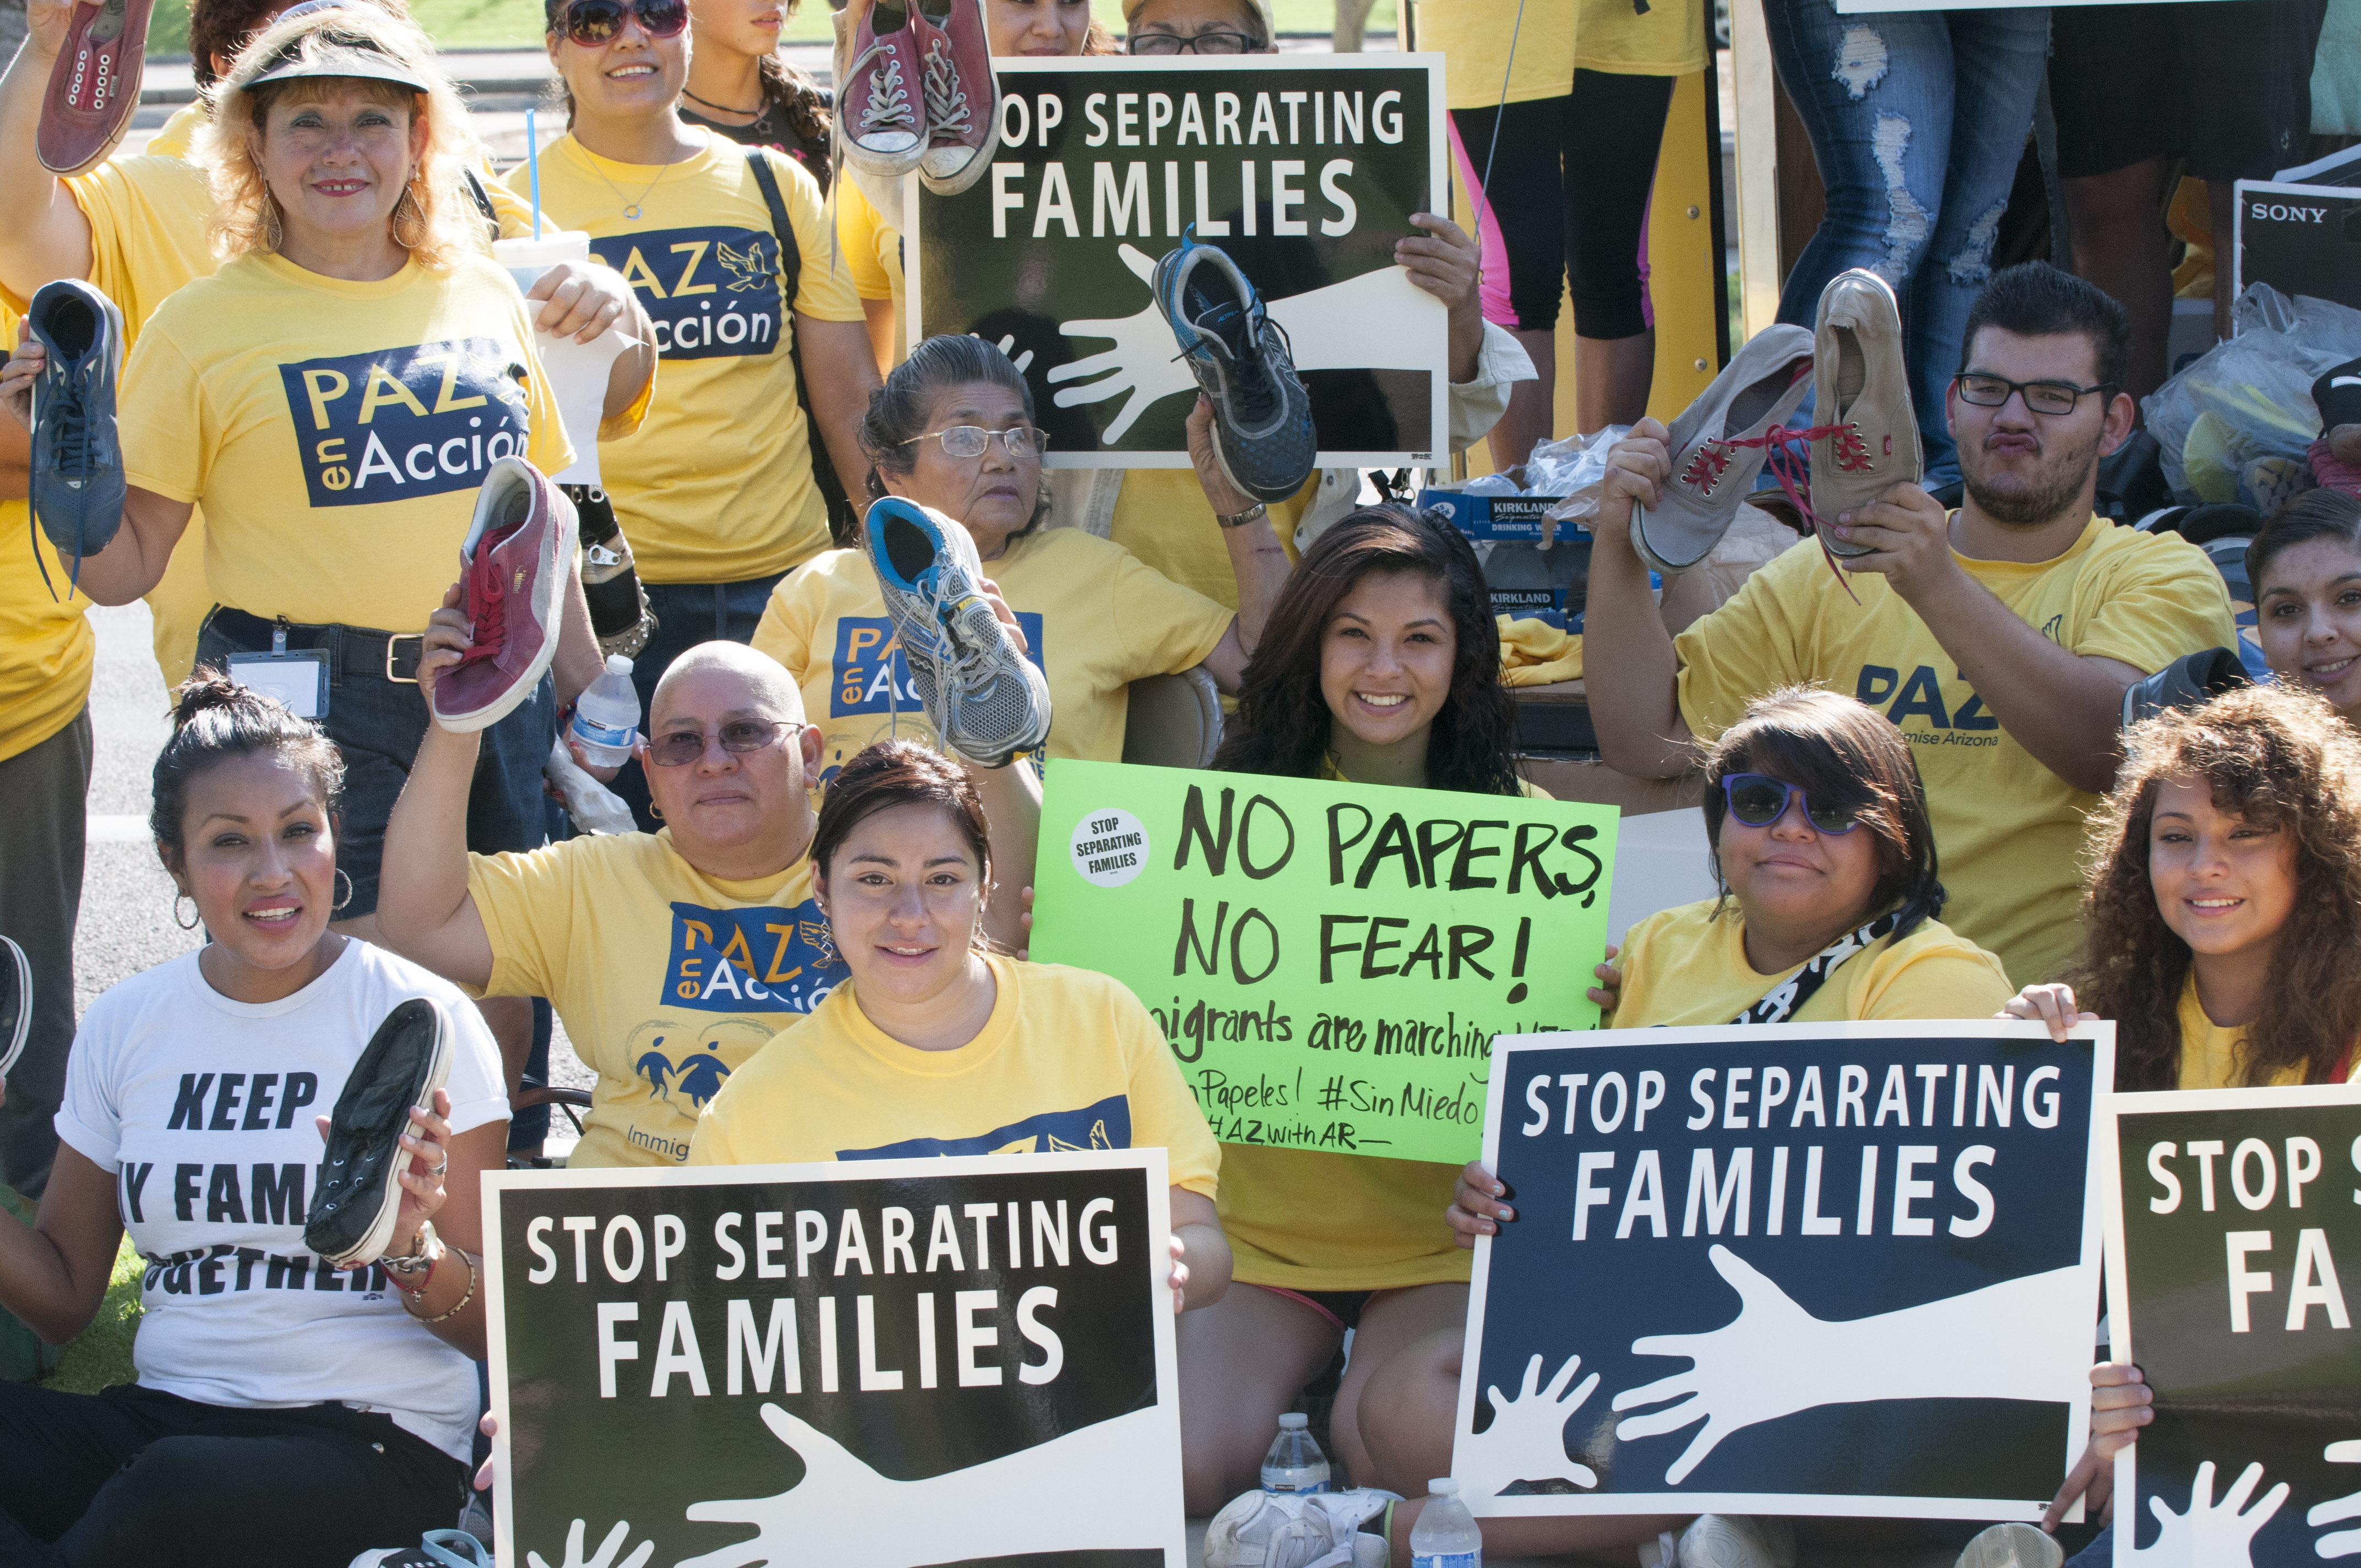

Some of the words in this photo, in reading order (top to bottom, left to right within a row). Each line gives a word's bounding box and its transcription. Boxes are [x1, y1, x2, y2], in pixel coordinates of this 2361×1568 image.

[1002, 92, 1063, 146] OP
[1085, 90, 1403, 146] SEPARATING
[992, 159, 1357, 238] FAMILIES
[2251, 203, 2327, 223] SONY
[590, 241, 717, 300] AZ
[654, 300, 771, 352] cción
[302, 352, 488, 430] PAZ
[316, 438, 351, 491] en
[1490, 593, 1551, 603] KIRKLAND
[847, 628, 903, 663] PA
[841, 667, 863, 705] en
[1905, 731, 1940, 744] mise
[1943, 731, 1999, 747] Arizona
[1076, 832, 1143, 857] SEPARATING
[1091, 817, 1119, 835] STOP
[1173, 784, 1295, 880] NO
[1326, 802, 1603, 909] PAPERS,
[1089, 852, 1137, 874] FAMILIES
[682, 918, 803, 983] PAZ
[1173, 897, 1280, 985] NO
[1319, 914, 1531, 1004] FEAR!
[677, 958, 702, 999] en
[1307, 1012, 1367, 1053] are
[166, 1071, 318, 1131] KEEP
[1521, 1070, 1666, 1137] STOP
[1687, 1064, 2061, 1131] SEPARATING
[628, 1124, 690, 1162] Immig
[1572, 1145, 1996, 1242] FAMILIES
[2147, 1136, 2322, 1215] STOP
[527, 1214, 687, 1285] STOP
[715, 1197, 1118, 1281] SEPARATING
[596, 1286, 1064, 1398] FAMILIES
